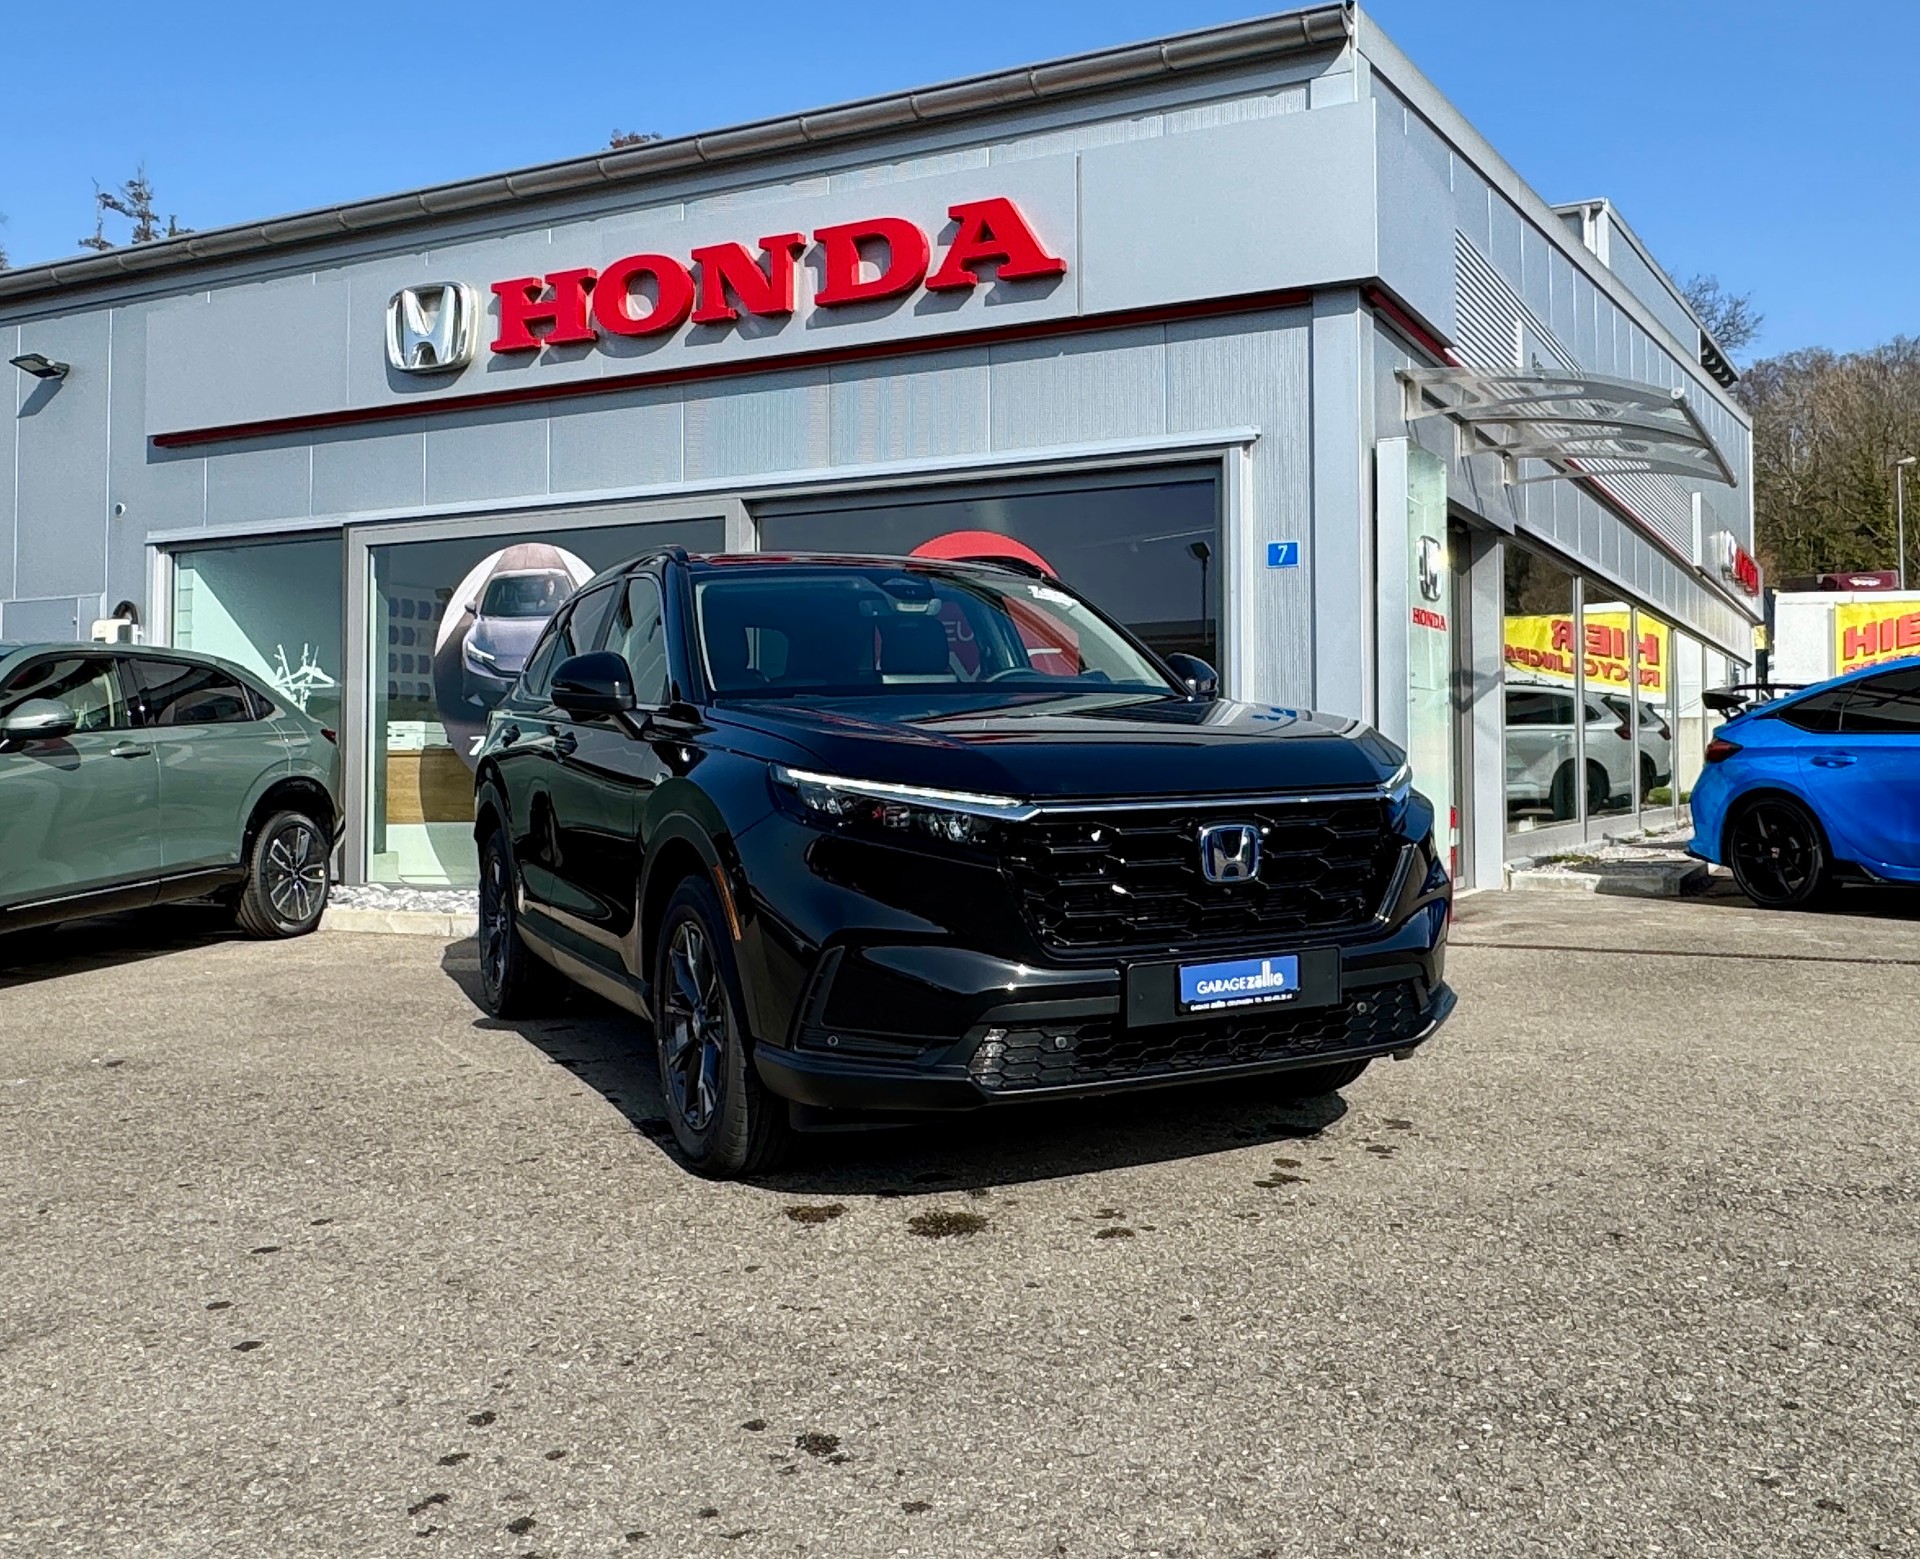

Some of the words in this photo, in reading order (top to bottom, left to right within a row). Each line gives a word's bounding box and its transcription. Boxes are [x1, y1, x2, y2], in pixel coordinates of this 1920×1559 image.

[490, 197, 1067, 353] HONDA
[1277, 544, 1288, 564] 7
[1412, 607, 1447, 631] HONDA
[1196, 977, 1246, 994] GARAGE
